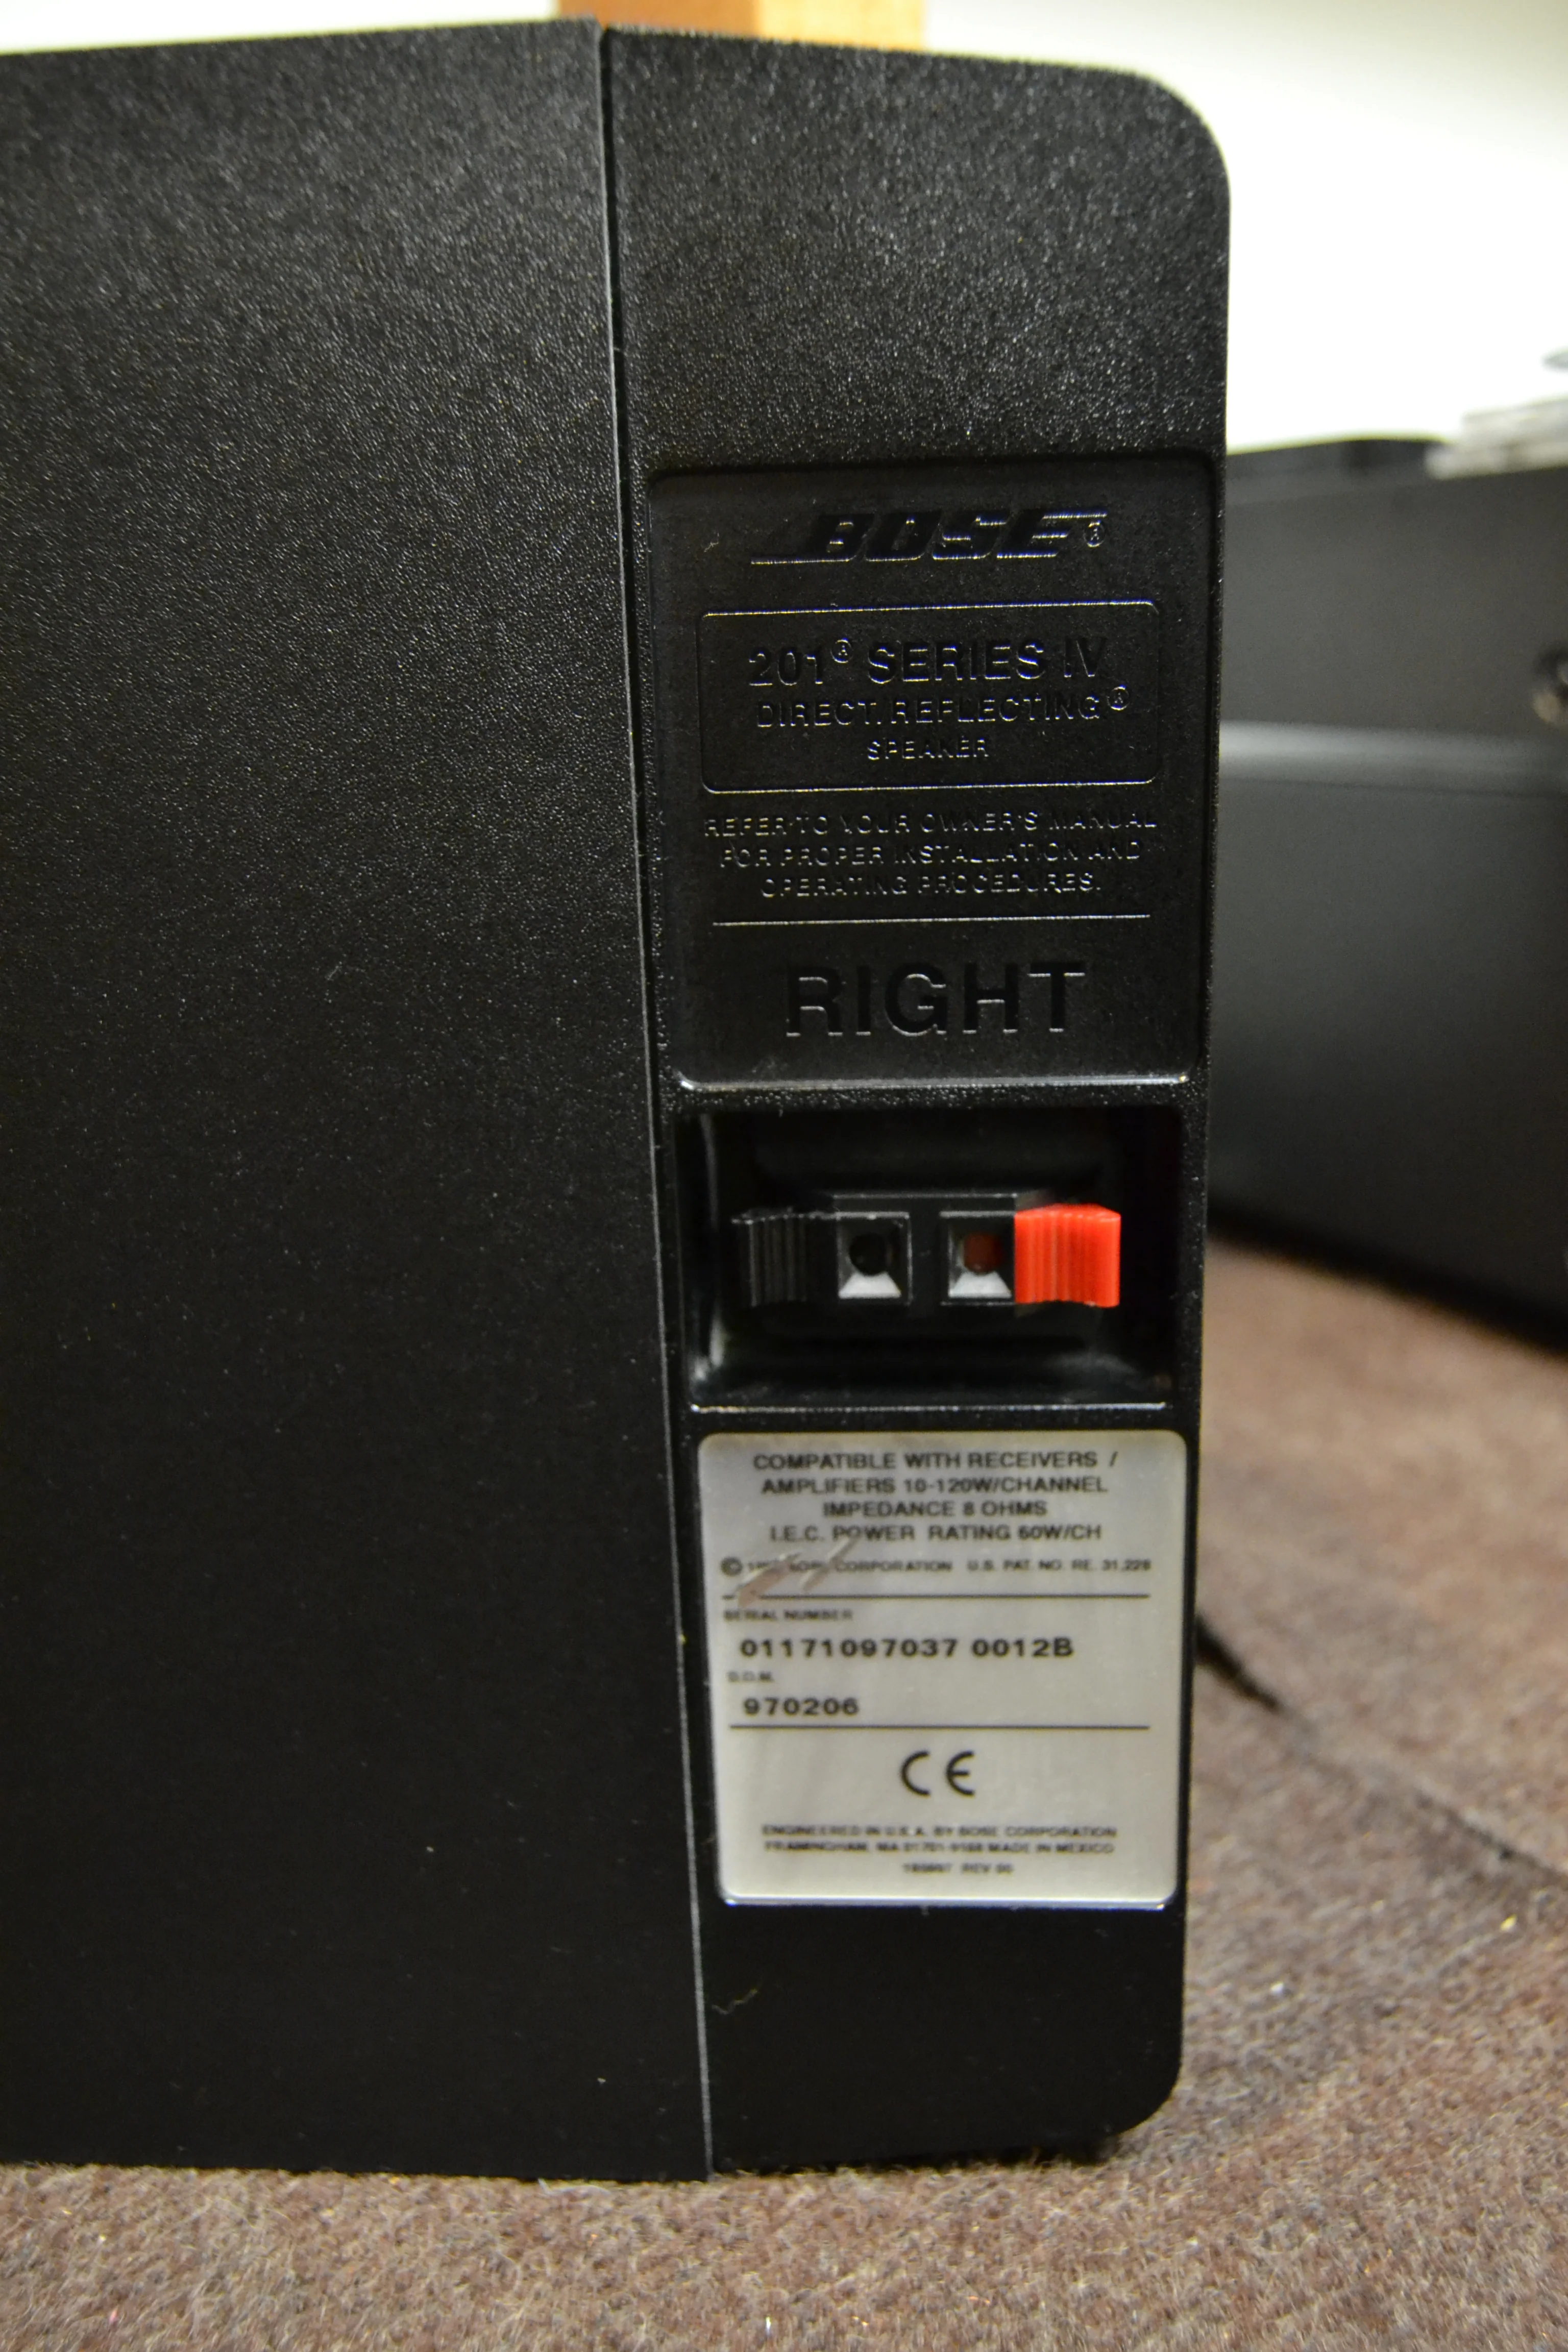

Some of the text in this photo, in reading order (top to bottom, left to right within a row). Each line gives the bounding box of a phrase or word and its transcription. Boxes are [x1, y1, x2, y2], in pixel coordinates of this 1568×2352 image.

[868, 640, 1047, 684] SERIES
[1063, 637, 1108, 678] IV
[867, 739, 989, 761] SPEAKER
[704, 817, 787, 837] REFER
[795, 815, 828, 835] TO
[837, 814, 911, 835] YOUR
[1048, 811, 1158, 830] MANUAL
[720, 840, 1142, 868] FOR PROPER INSTALLATION AND
[761, 875, 908, 899] OPERATING
[785, 960, 1087, 1037] RIGHT
[753, 1453, 896, 1471] COMPATIBLE
[905, 1452, 963, 1469] WITH
[968, 1452, 1098, 1469] RECEIVERS
[761, 1477, 1109, 1494] AMPLIFIERS 10-120W/CHANNEL
[823, 1501, 1048, 1518] IMPEDANCE 8 OHMS
[770, 1525, 825, 1541] I.E.C.
[832, 1525, 916, 1541] POWER
[928, 1525, 1011, 1541] RATING
[723, 1609, 853, 1622] SERIAL NUMBER
[740, 1637, 1074, 1658] 01171097037 0012B
[744, 1698, 860, 1716] 970206
[899, 1750, 976, 1797] CE
[1004, 1826, 1118, 1837] CORPORATION
[989, 1842, 1030, 1853] MADE
[1036, 1842, 1052, 1853] IN
[1056, 1842, 1115, 1854] MEXICO
